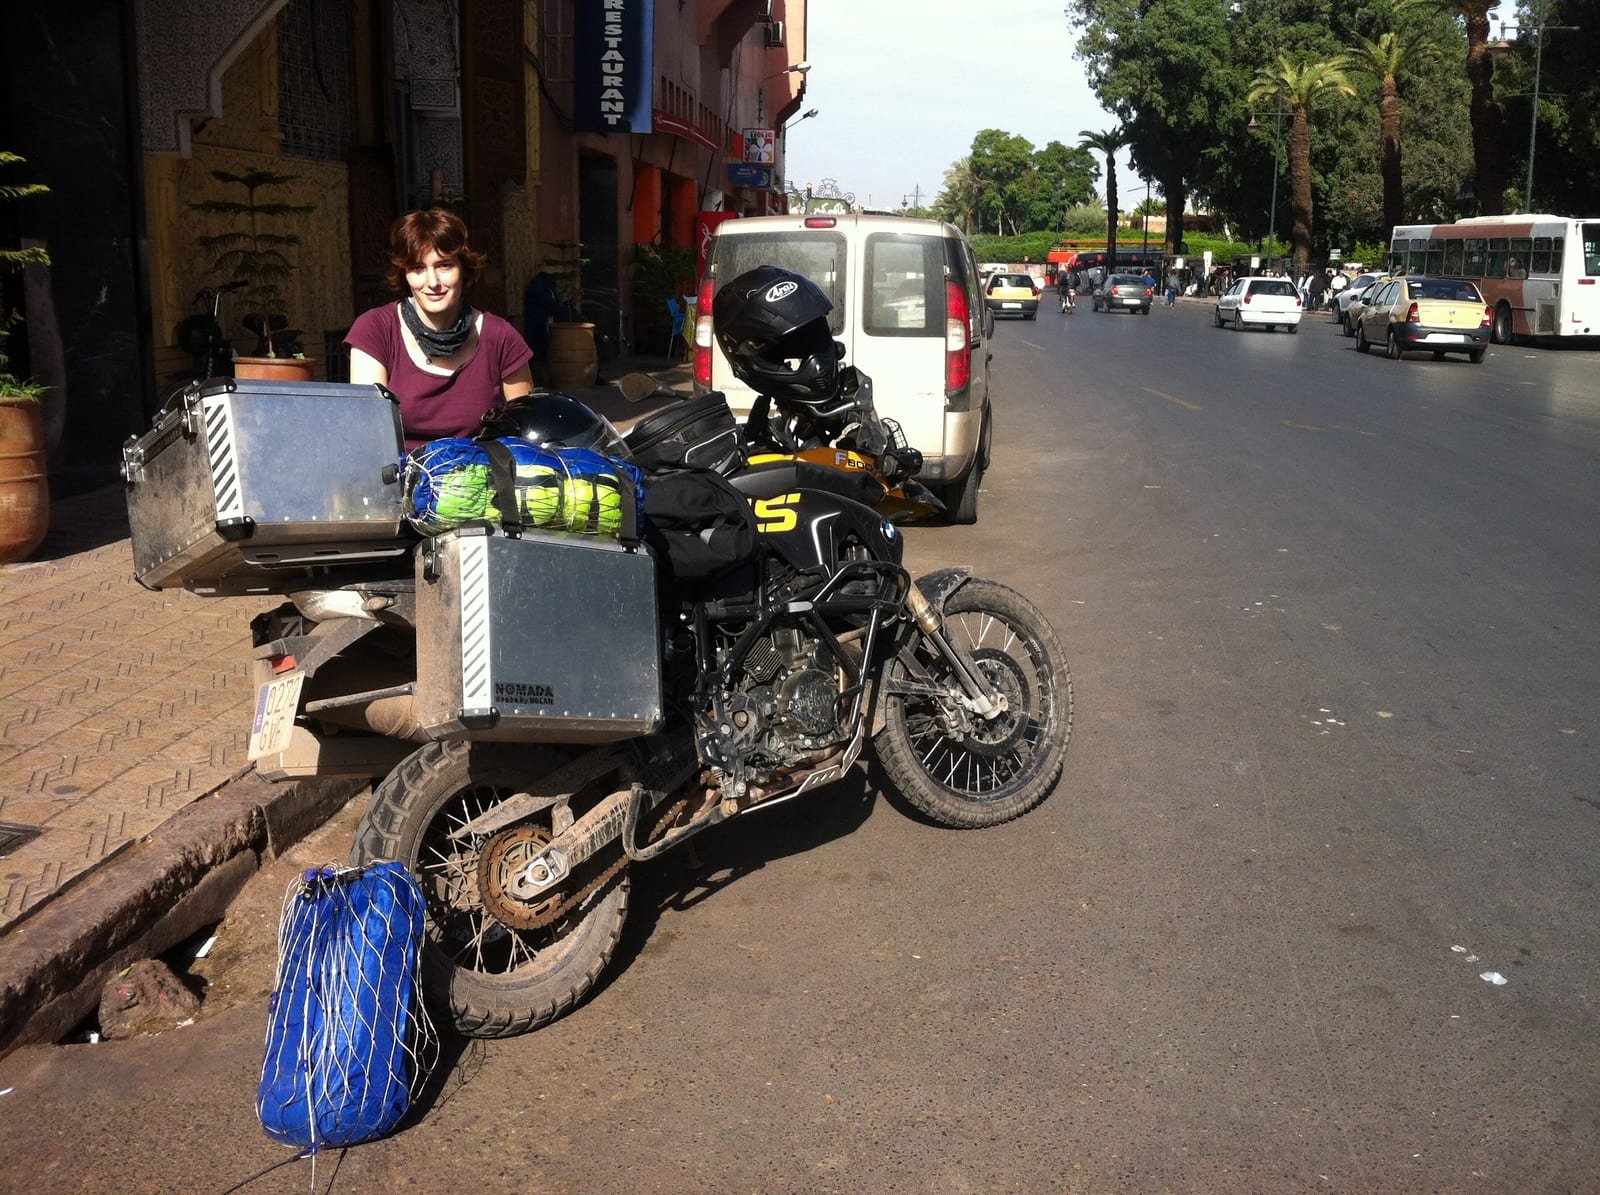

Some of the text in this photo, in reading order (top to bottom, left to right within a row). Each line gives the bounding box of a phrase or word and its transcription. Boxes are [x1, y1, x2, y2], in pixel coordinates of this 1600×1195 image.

[600, 0, 625, 125] RESTAURANT
[767, 282, 796, 301] Arai
[747, 493, 801, 532] S
[266, 676, 300, 716] 0272
[495, 682, 553, 697] NOMADA
